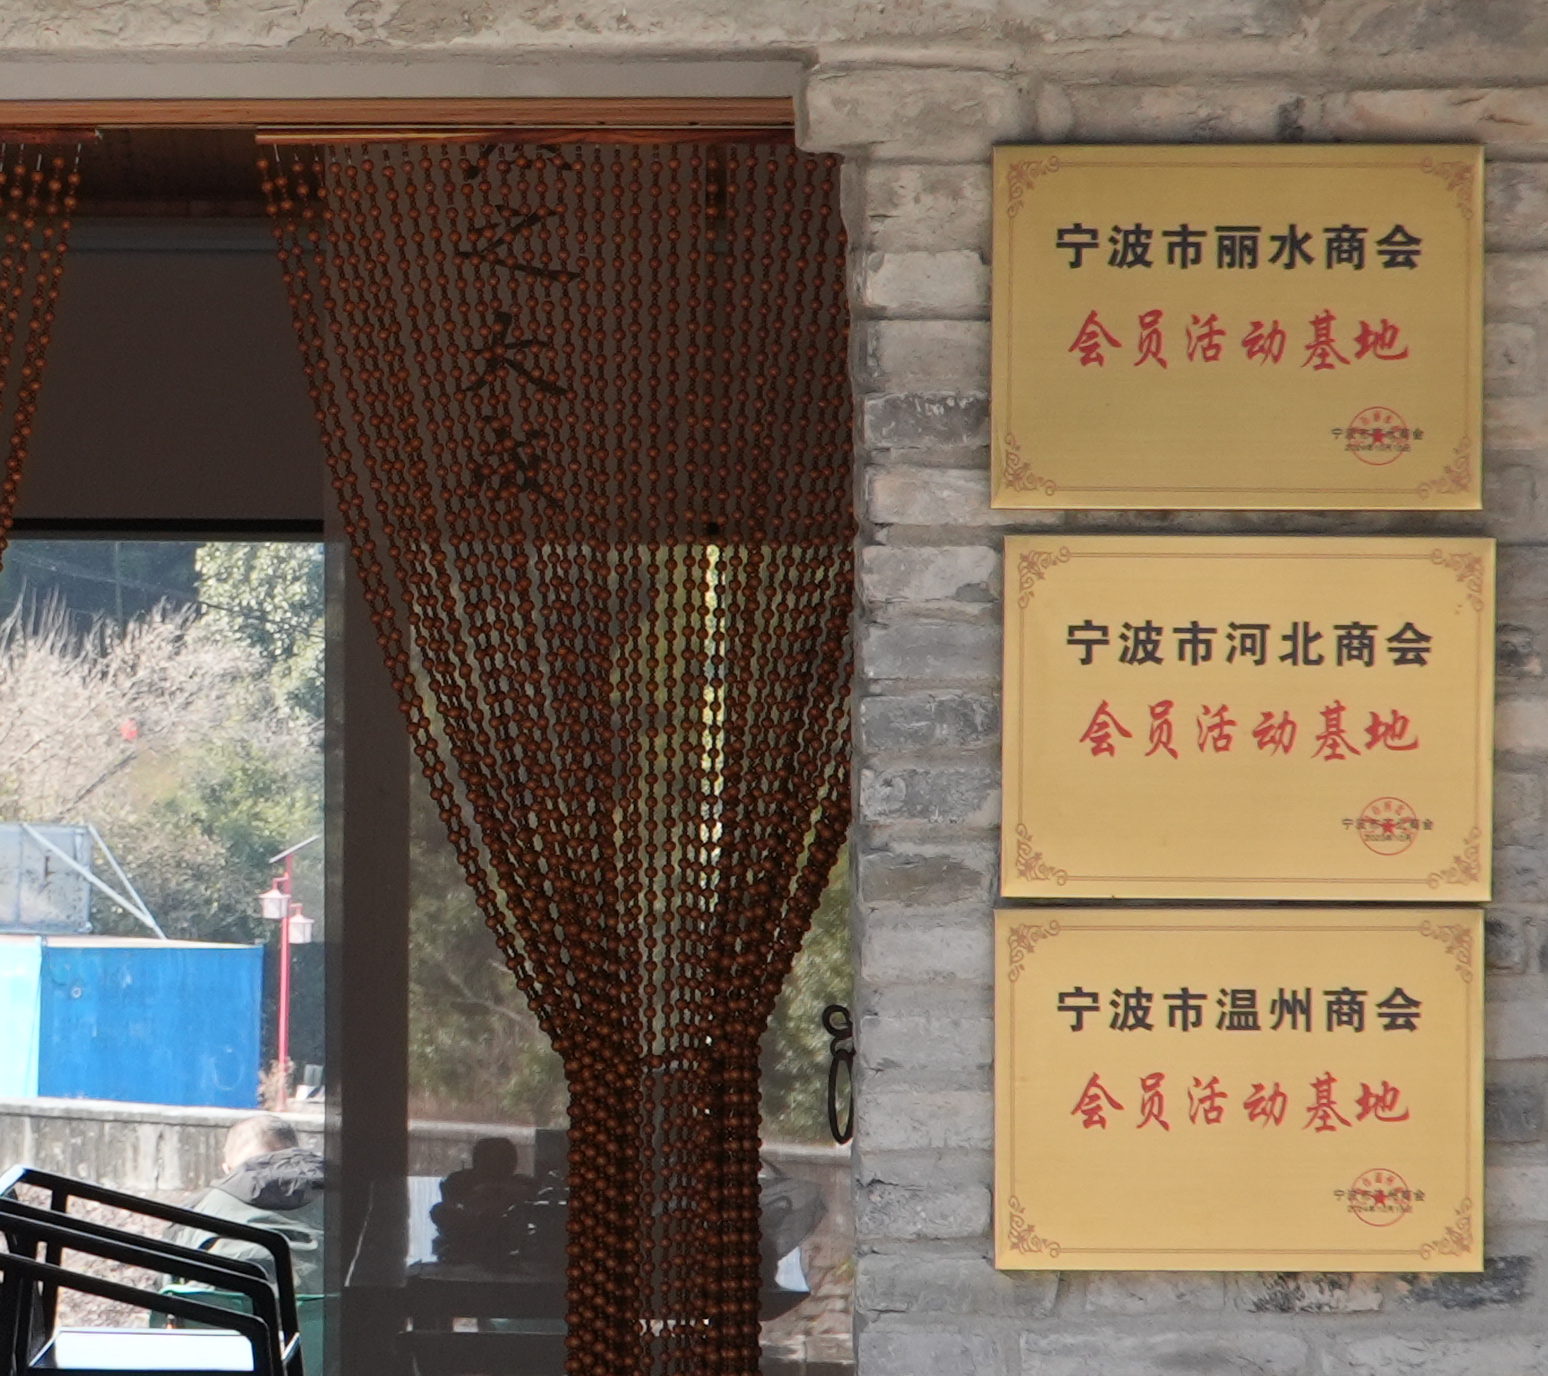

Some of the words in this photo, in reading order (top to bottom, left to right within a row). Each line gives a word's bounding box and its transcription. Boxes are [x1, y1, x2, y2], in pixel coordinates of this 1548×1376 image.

[1055, 222, 1423, 270] 宁波市丽水商会
[1067, 308, 1409, 371] 会员活动基地
[1066, 619, 1433, 668] 宁波市河北商会
[1078, 699, 1420, 762] 会员活动基地
[1056, 985, 1423, 1033] 宁波市温州商会
[1070, 1071, 1410, 1133] 会员活动基地
